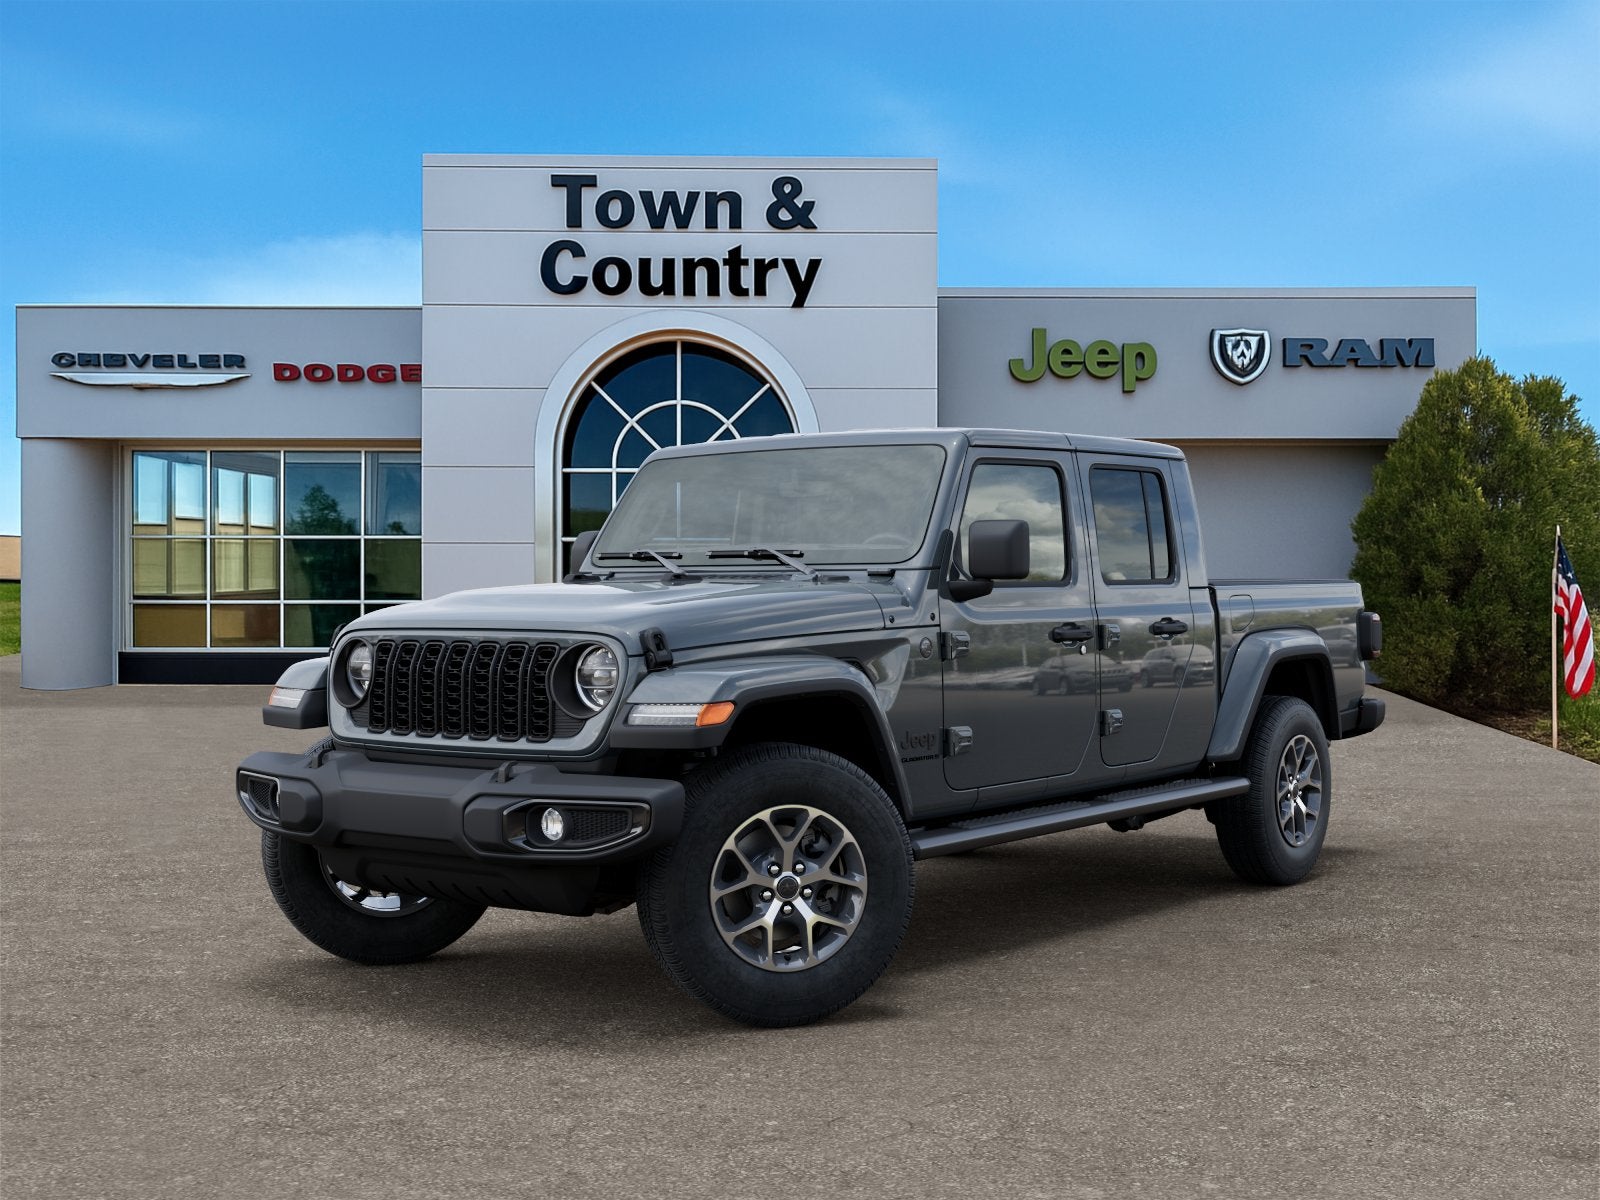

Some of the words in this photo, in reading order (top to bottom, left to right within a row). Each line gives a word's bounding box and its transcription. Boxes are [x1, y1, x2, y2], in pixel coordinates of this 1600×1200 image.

[550, 174, 742, 230] Town
[765, 175, 818, 230] &
[540, 239, 823, 308] Country
[273, 362, 422, 383] DODGE
[1009, 327, 1157, 393] Jeep
[1282, 337, 1435, 367] RAM
[900, 731, 936, 751] Jeep
